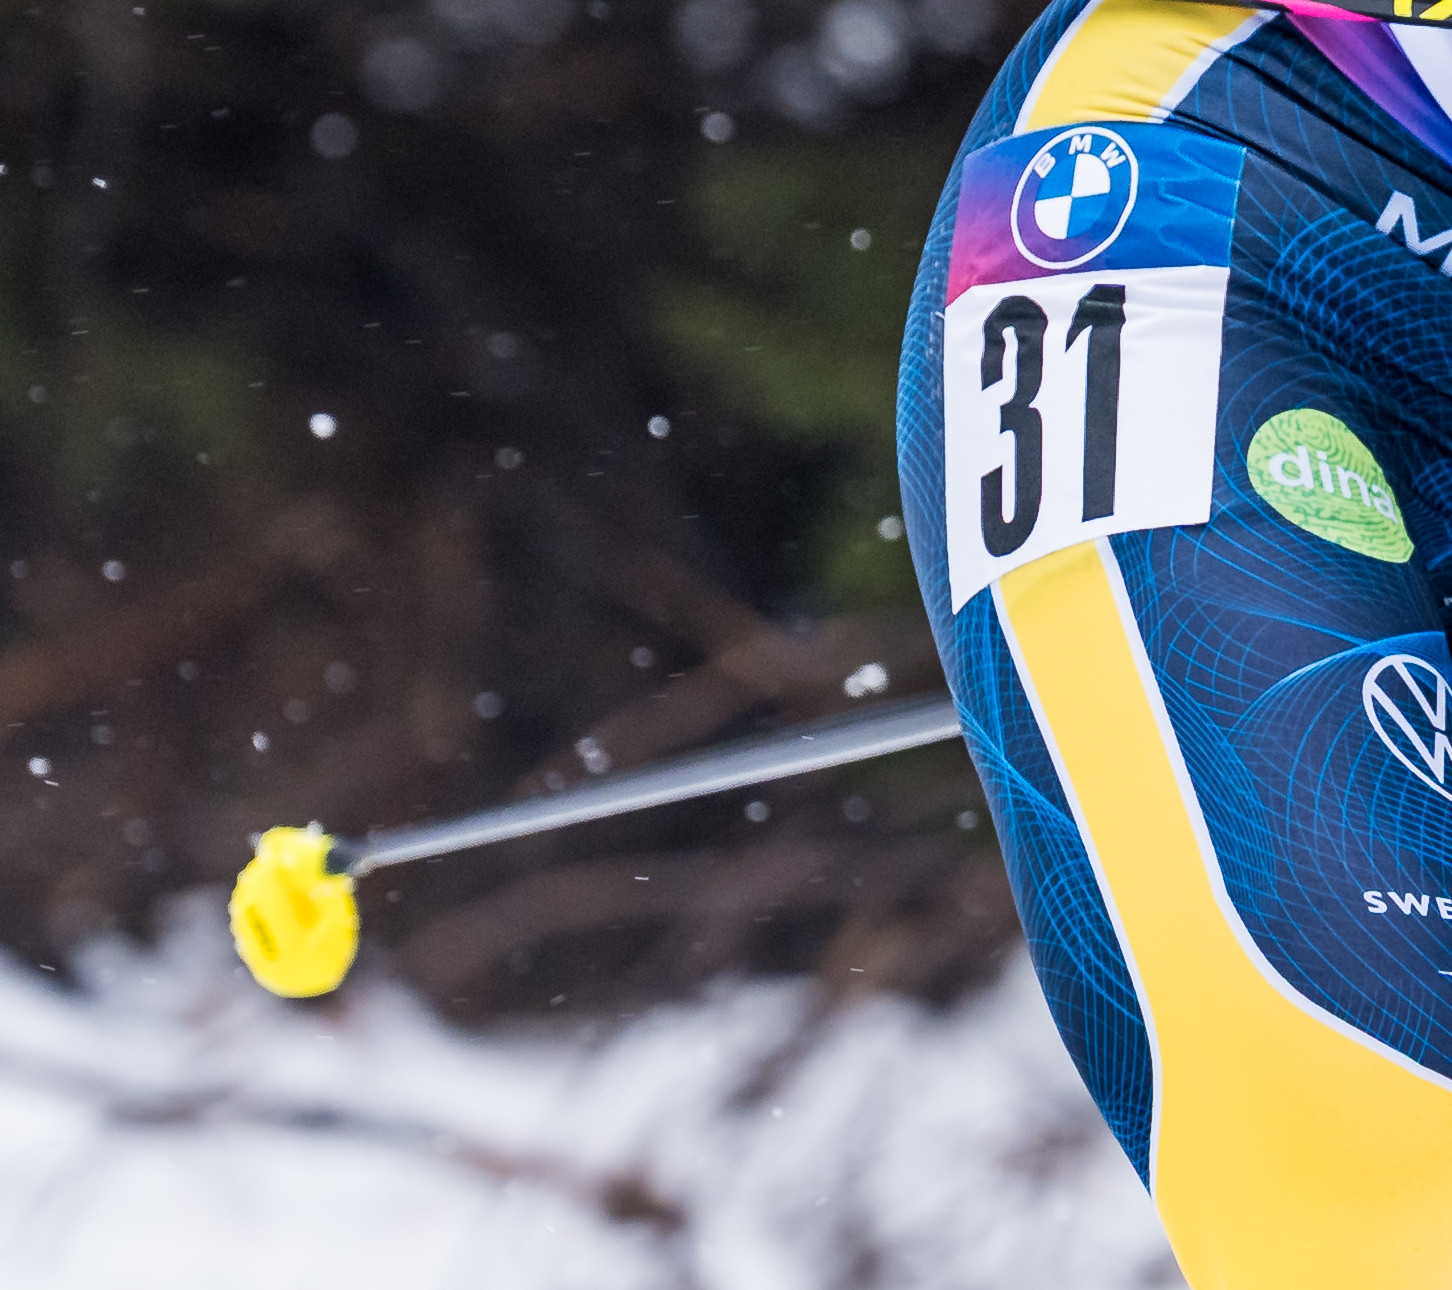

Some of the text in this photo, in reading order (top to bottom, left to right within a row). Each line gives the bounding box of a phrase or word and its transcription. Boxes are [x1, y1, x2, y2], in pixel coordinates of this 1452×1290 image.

[1033, 133, 1127, 179] BMW
[981, 283, 1126, 559] 31
[1268, 445, 1398, 524] dina
